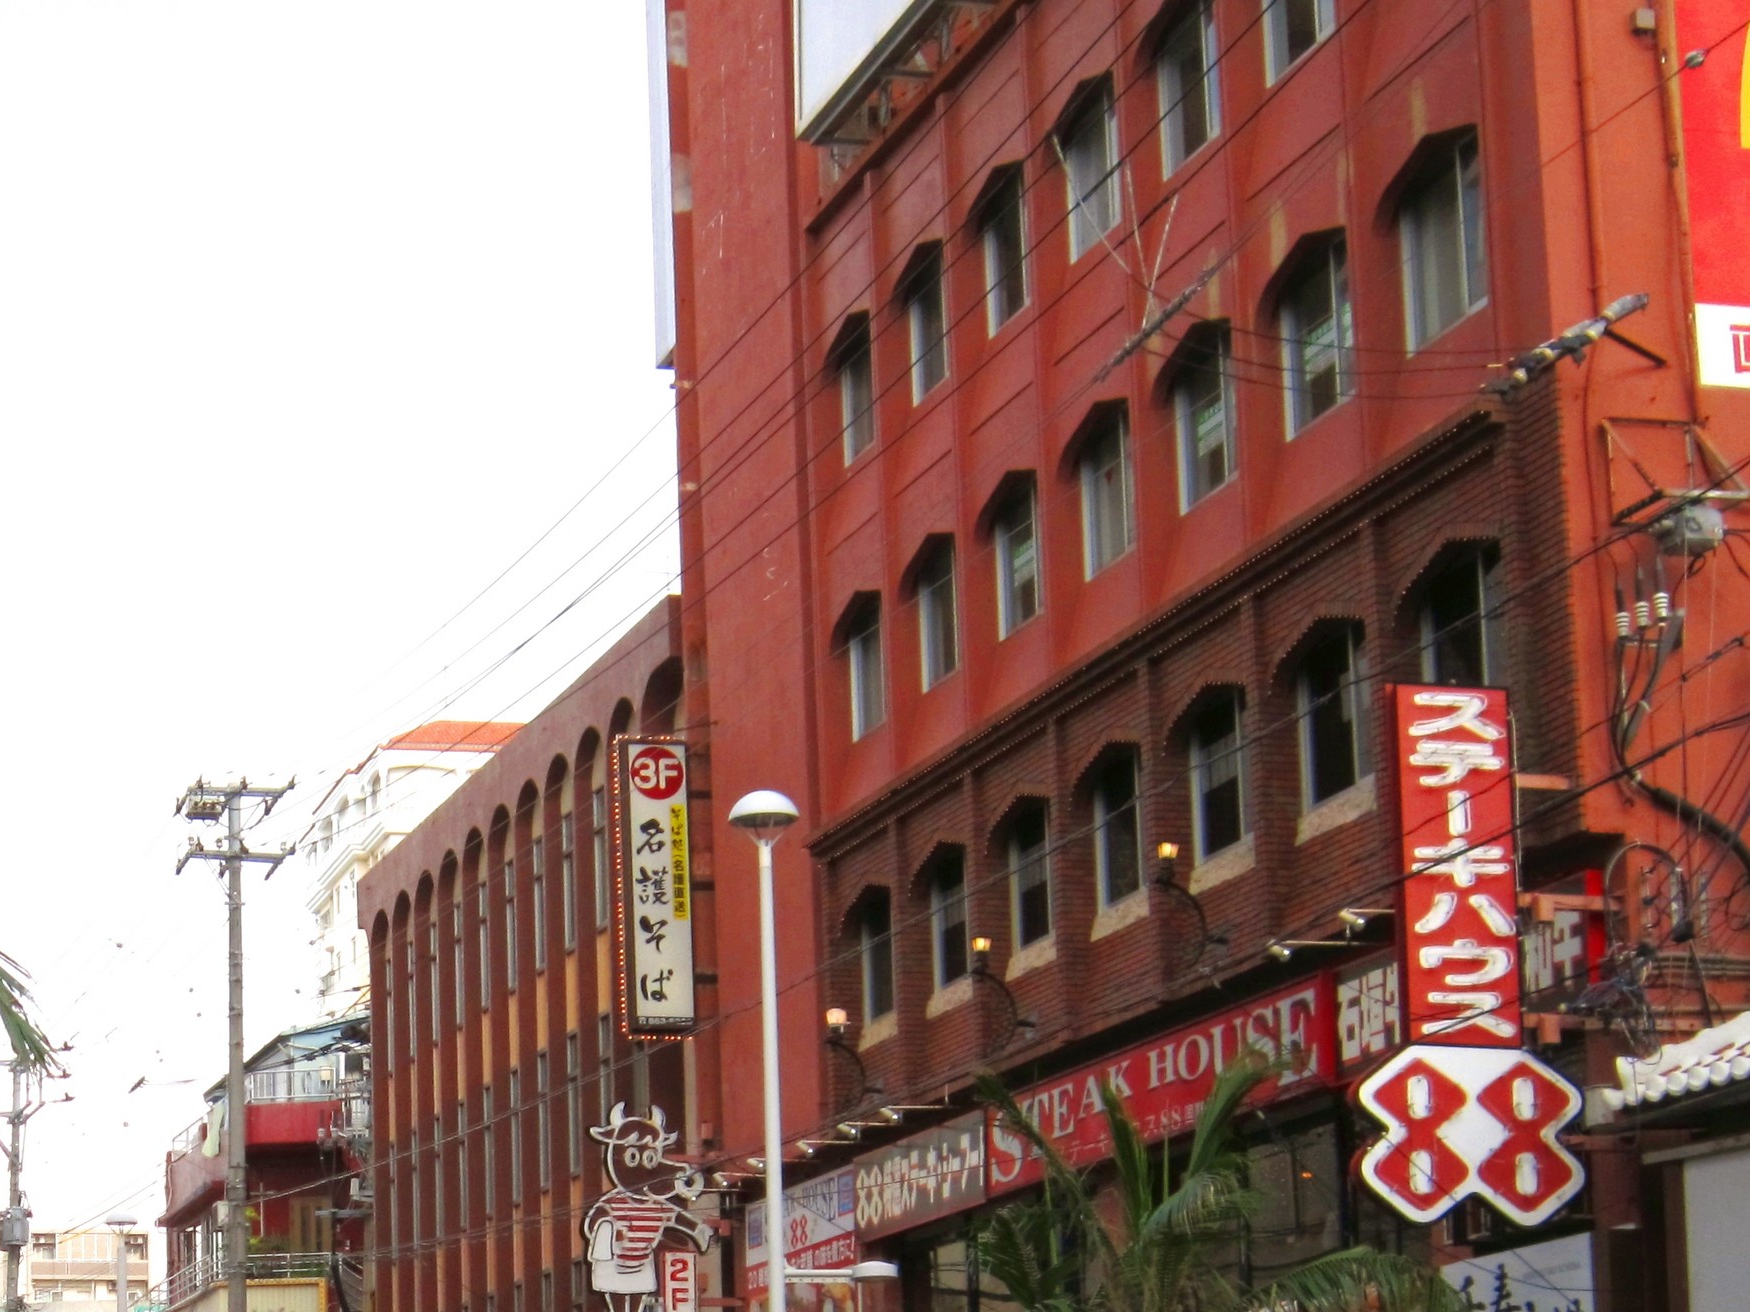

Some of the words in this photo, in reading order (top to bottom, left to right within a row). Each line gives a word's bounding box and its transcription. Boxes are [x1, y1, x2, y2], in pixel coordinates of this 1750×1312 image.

[633, 757, 680, 790] 3F
[635, 817, 674, 1002] 名護そば
[1408, 690, 1517, 1039] ステーキハウス
[991, 1059, 1134, 1186] STEAK
[1146, 988, 1318, 1090] HOUSE
[1370, 1055, 1576, 1214] 88
[670, 1258, 690, 1311] 2F
